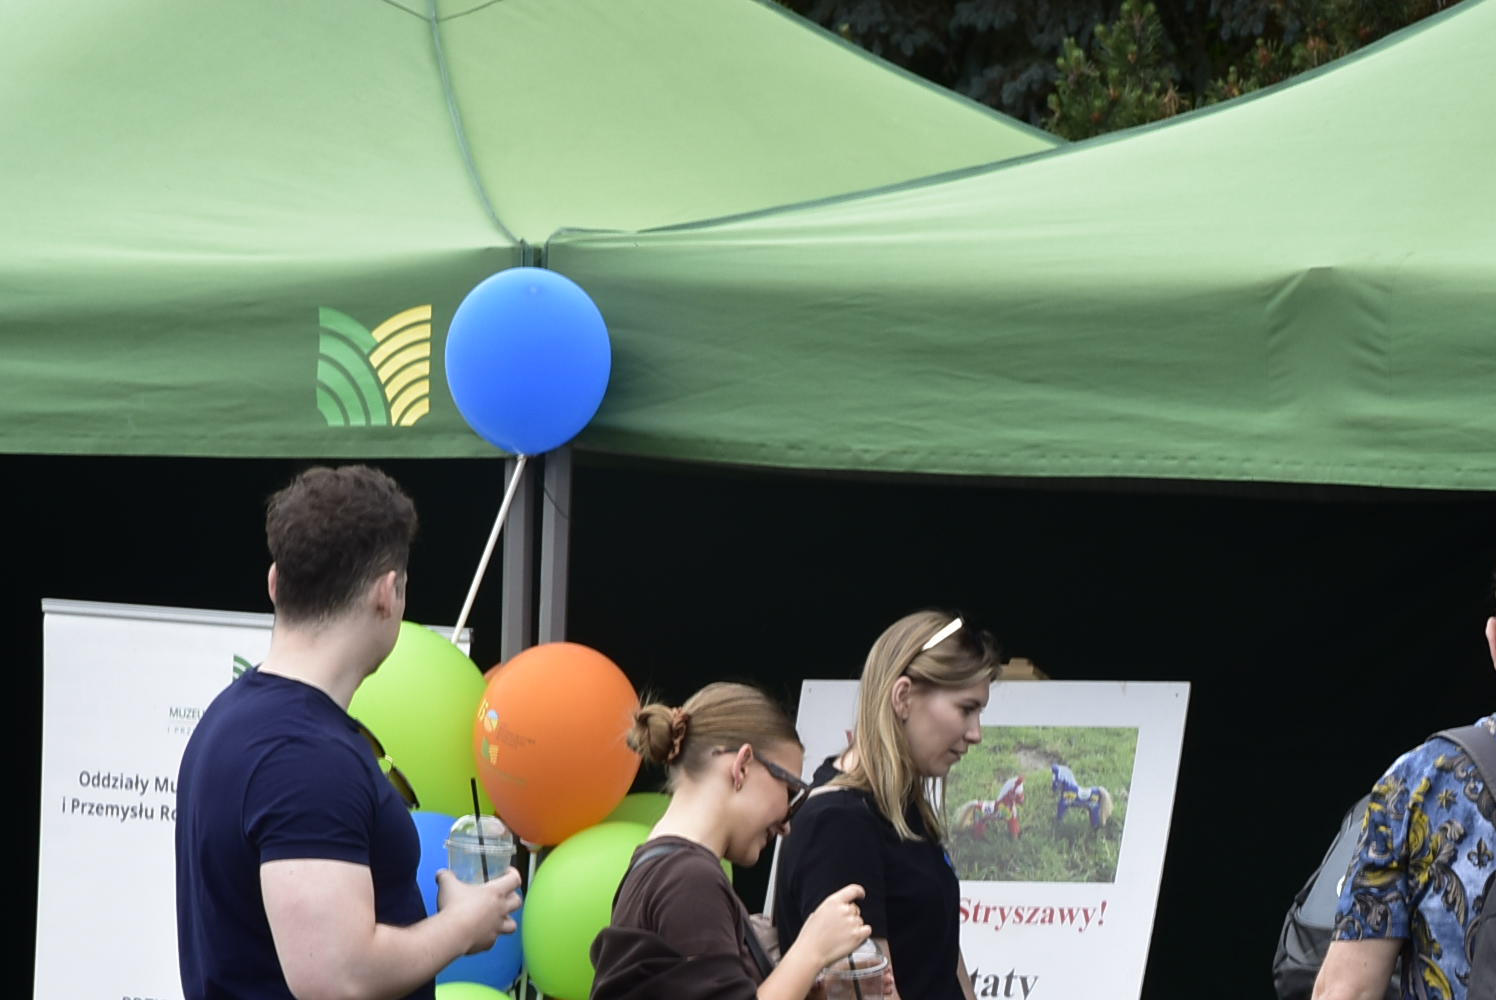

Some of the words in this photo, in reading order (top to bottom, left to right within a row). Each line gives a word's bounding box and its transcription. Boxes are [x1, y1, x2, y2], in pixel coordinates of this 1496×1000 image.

[79, 770, 149, 796] Oddziały
[71, 798, 154, 823] Przemysłu
[960, 897, 1107, 933] Stryszawy!
